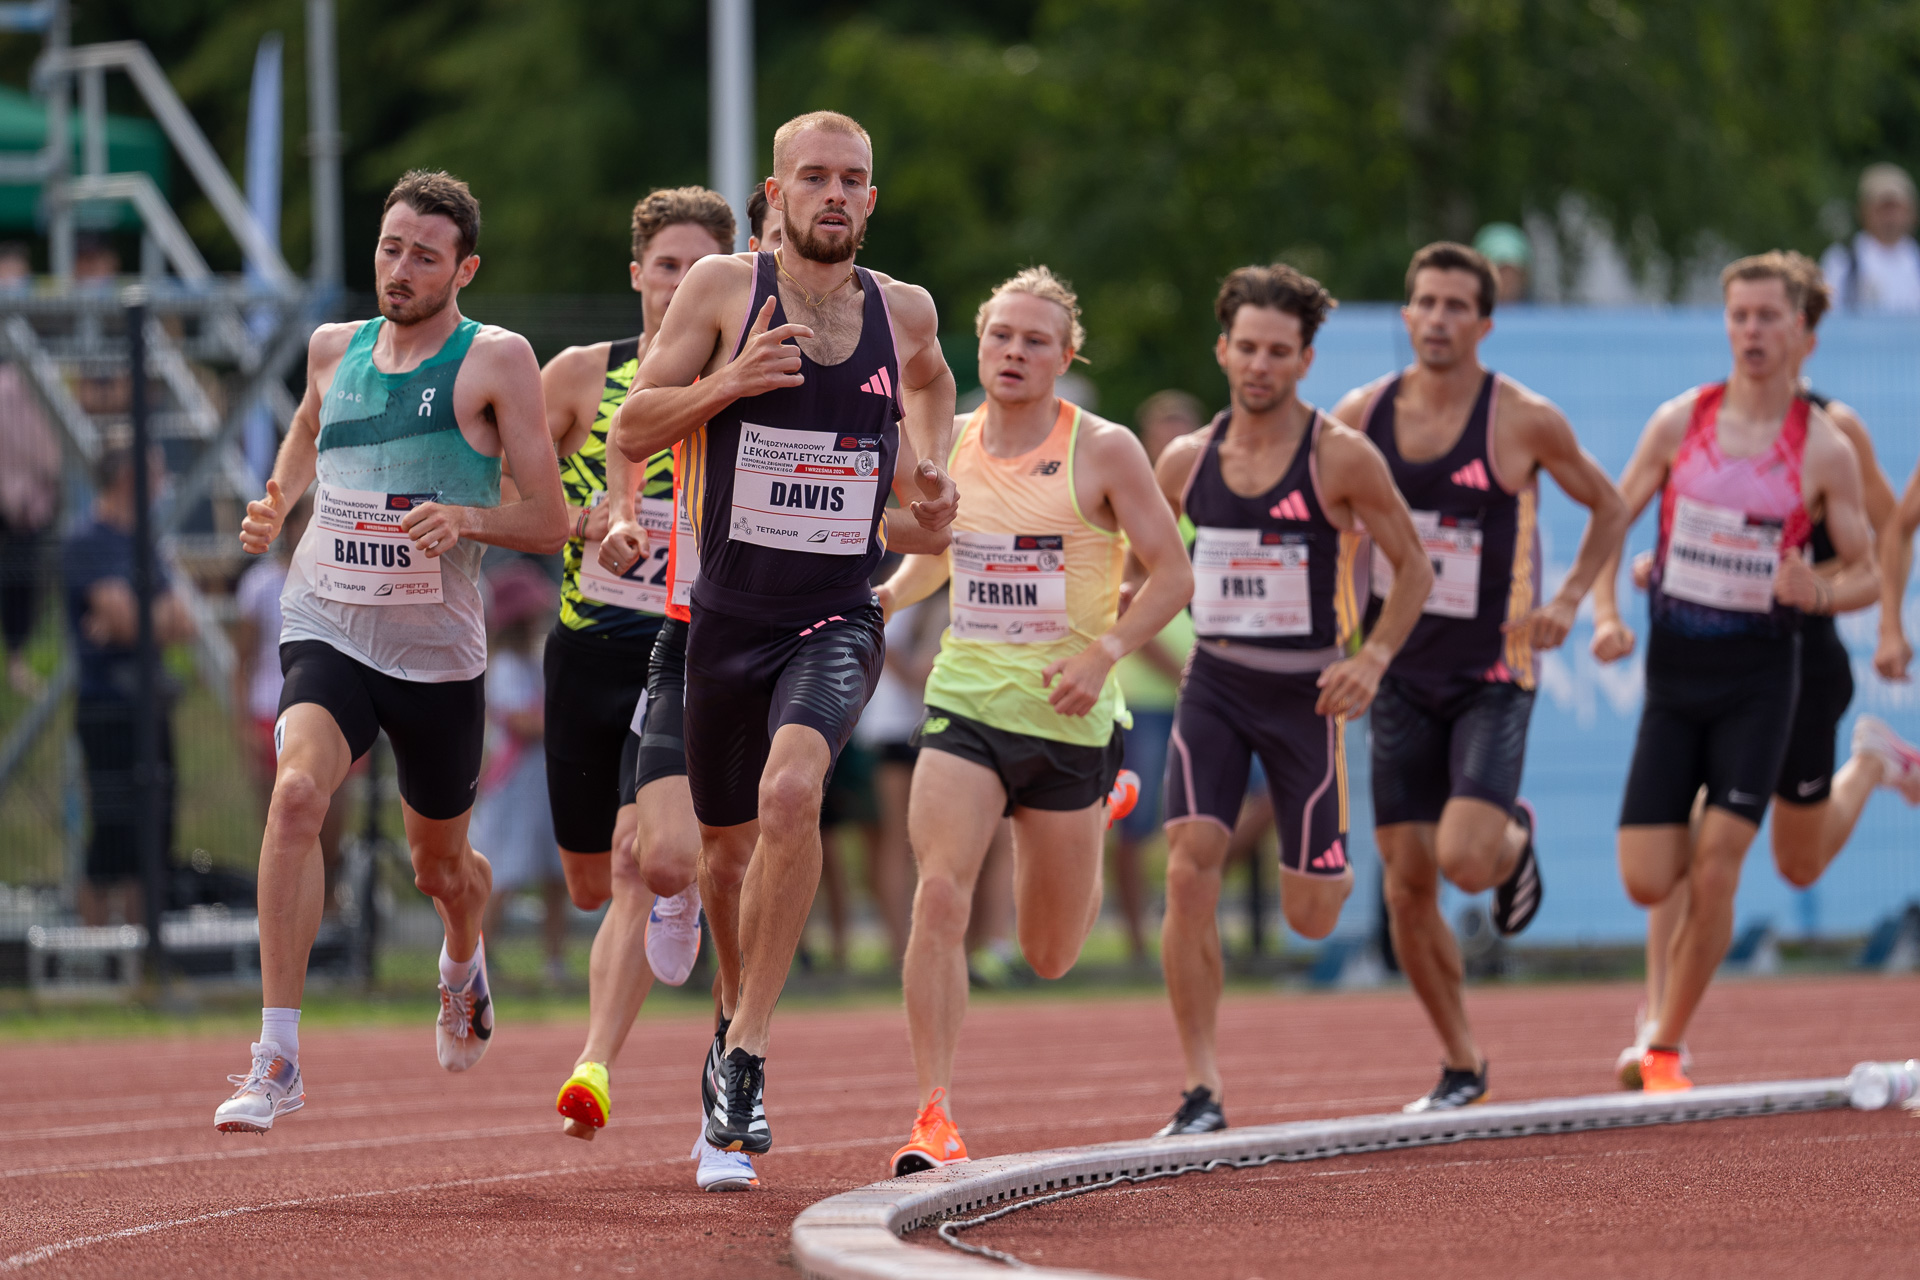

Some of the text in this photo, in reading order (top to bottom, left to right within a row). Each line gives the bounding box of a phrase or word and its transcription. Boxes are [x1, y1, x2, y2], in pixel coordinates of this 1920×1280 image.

[337, 390, 362, 403] OAC
[745, 430, 826, 451] IV MIĘDZYNARODOWY
[743, 445, 848, 465] LEKKOATLETYCZNY
[321, 489, 330, 501] IV
[770, 481, 845, 512] DAVIS
[320, 504, 401, 523] LEKKOATLETYCZNY
[755, 525, 798, 537] TETRAPUR
[839, 537, 867, 545] SPORT
[334, 538, 411, 568] BALTUS
[334, 581, 366, 592] TETRAPUR
[405, 587, 440, 595] SPORT
[968, 580, 1038, 606] PERRIN
[1221, 575, 1267, 599] FRIS
